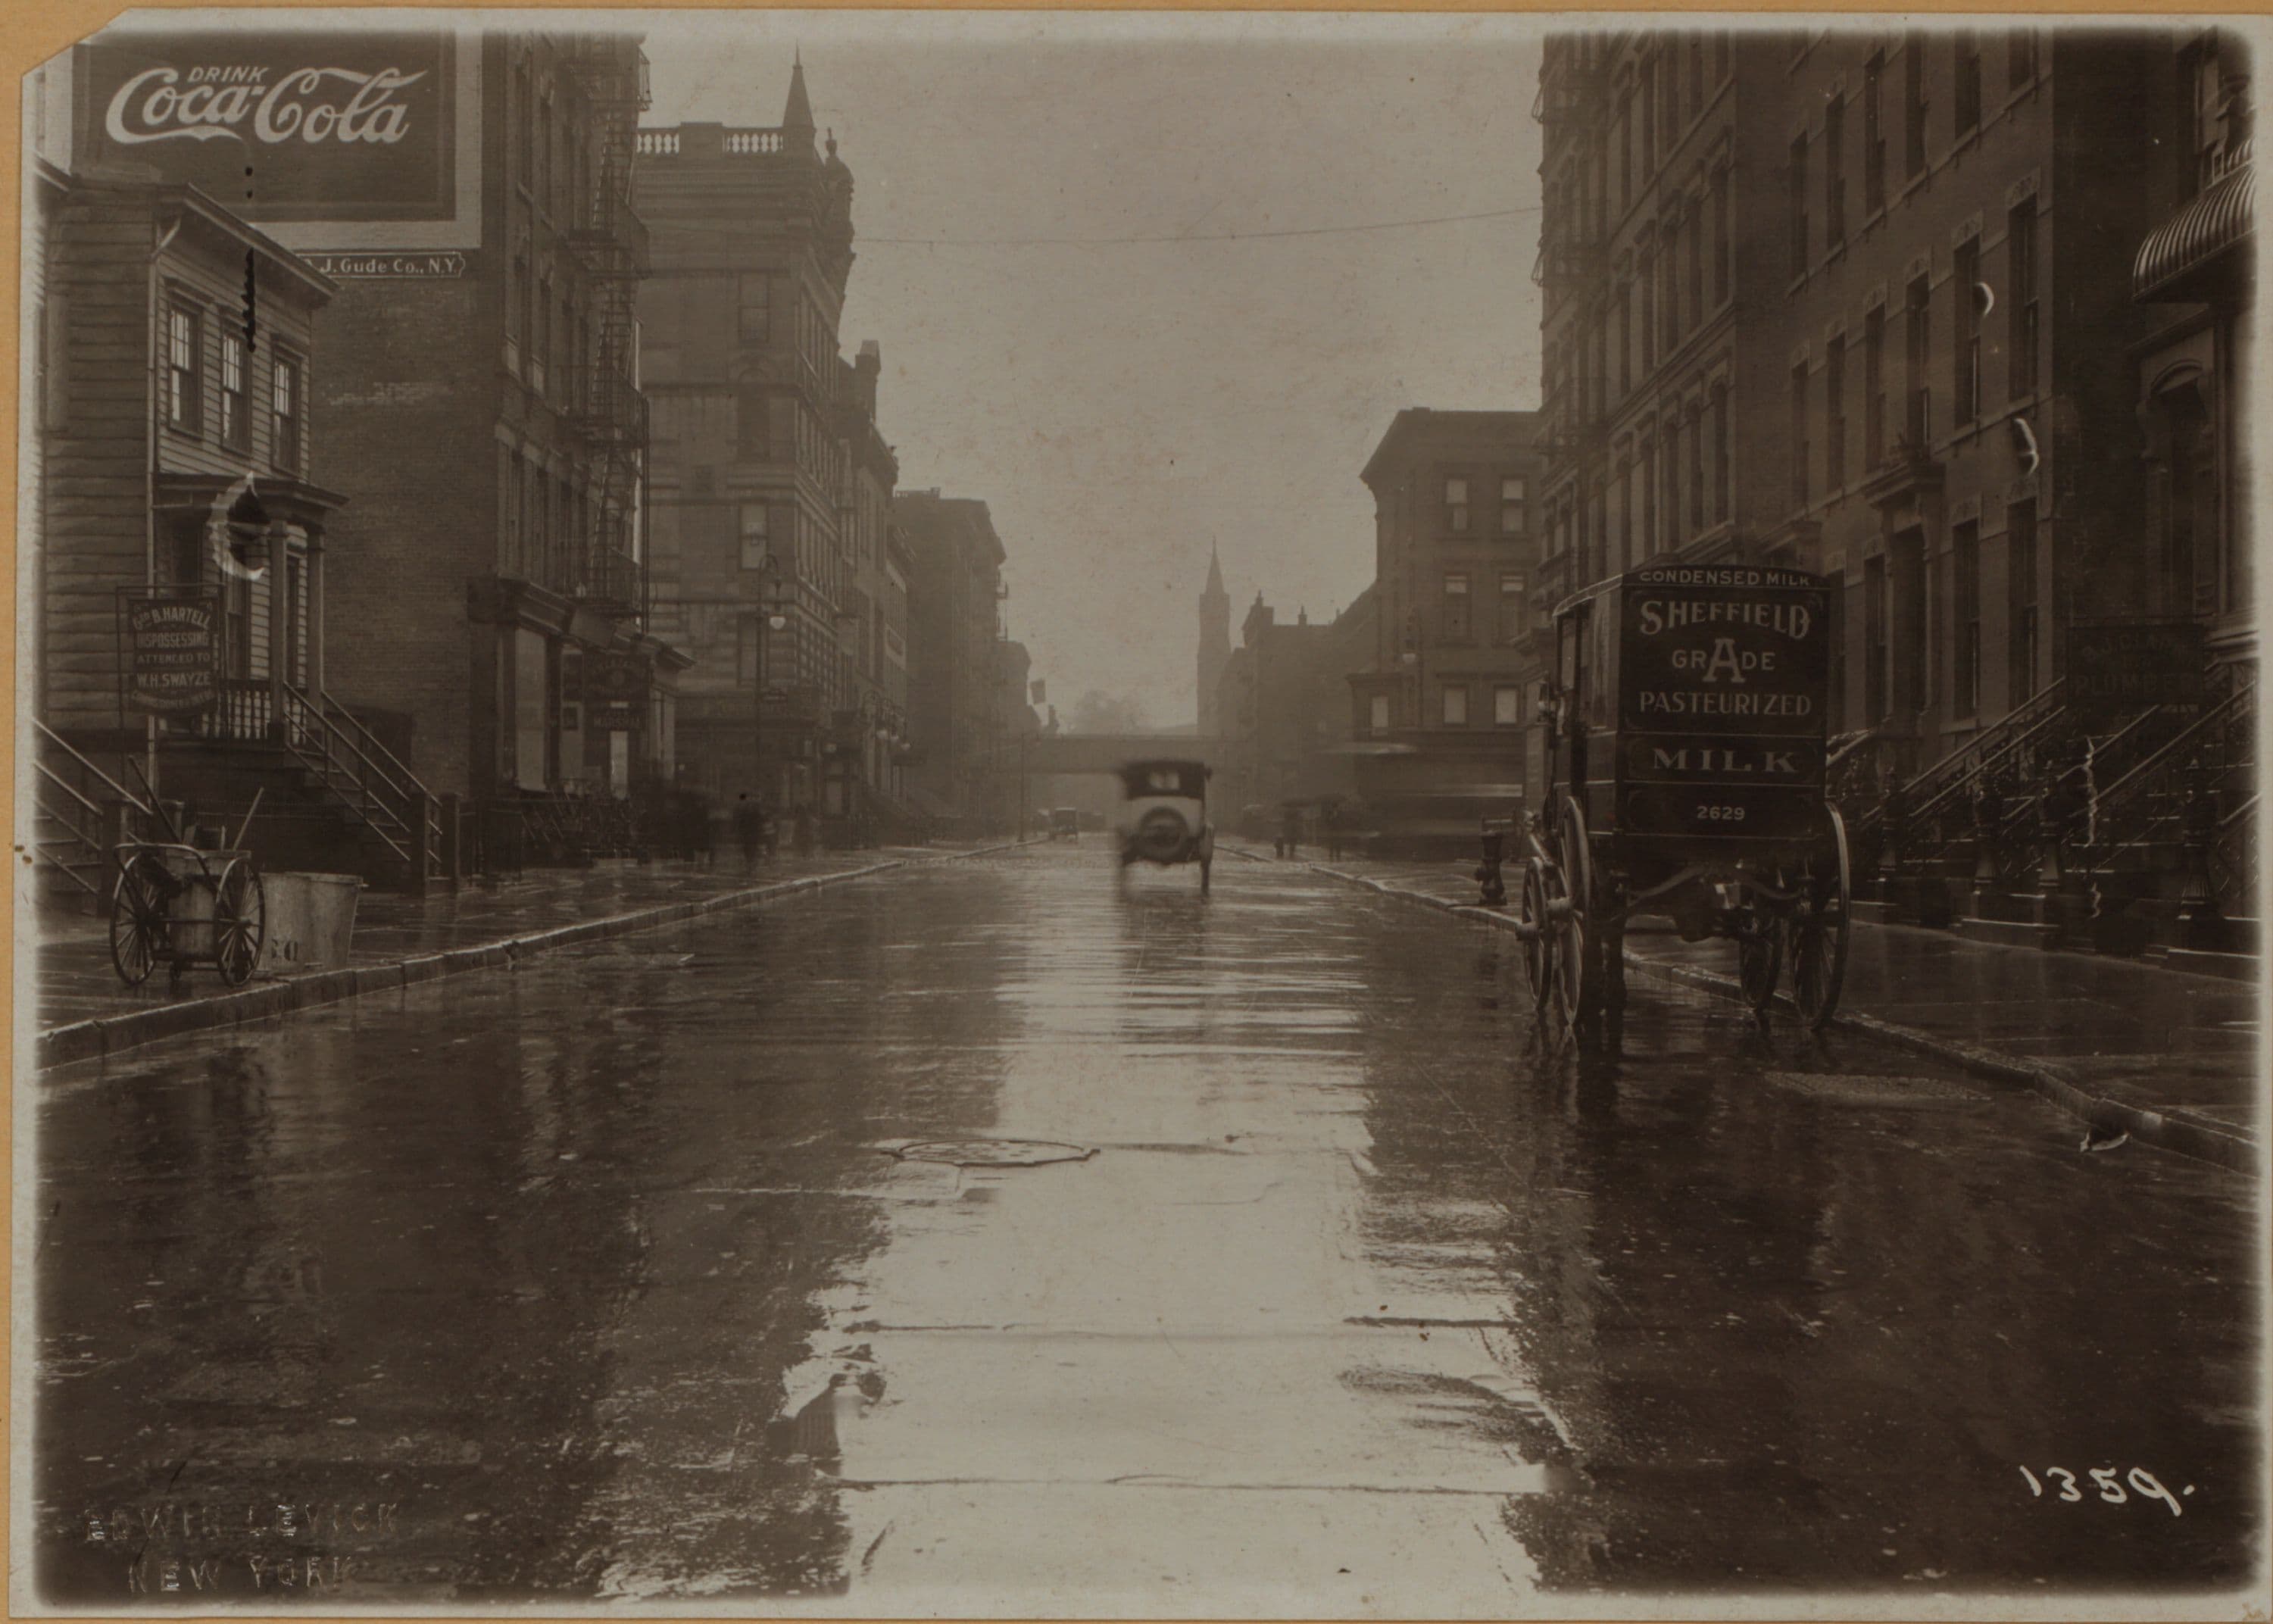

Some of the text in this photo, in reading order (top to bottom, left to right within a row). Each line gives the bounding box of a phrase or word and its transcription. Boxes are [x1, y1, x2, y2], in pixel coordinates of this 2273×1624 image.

[188, 65, 270, 83] DRINK
[105, 67, 429, 144] Coca-Cola
[1639, 569, 1810, 586] CONDENSED MILK
[1639, 600, 1812, 640] SHEFFIELD
[196, 652, 211, 664] TO
[1672, 637, 1776, 682] GRADE
[1639, 691, 1812, 717] PASTEURIZED
[1653, 748, 1800, 773] MILK
[1697, 805, 1745, 820] 2629
